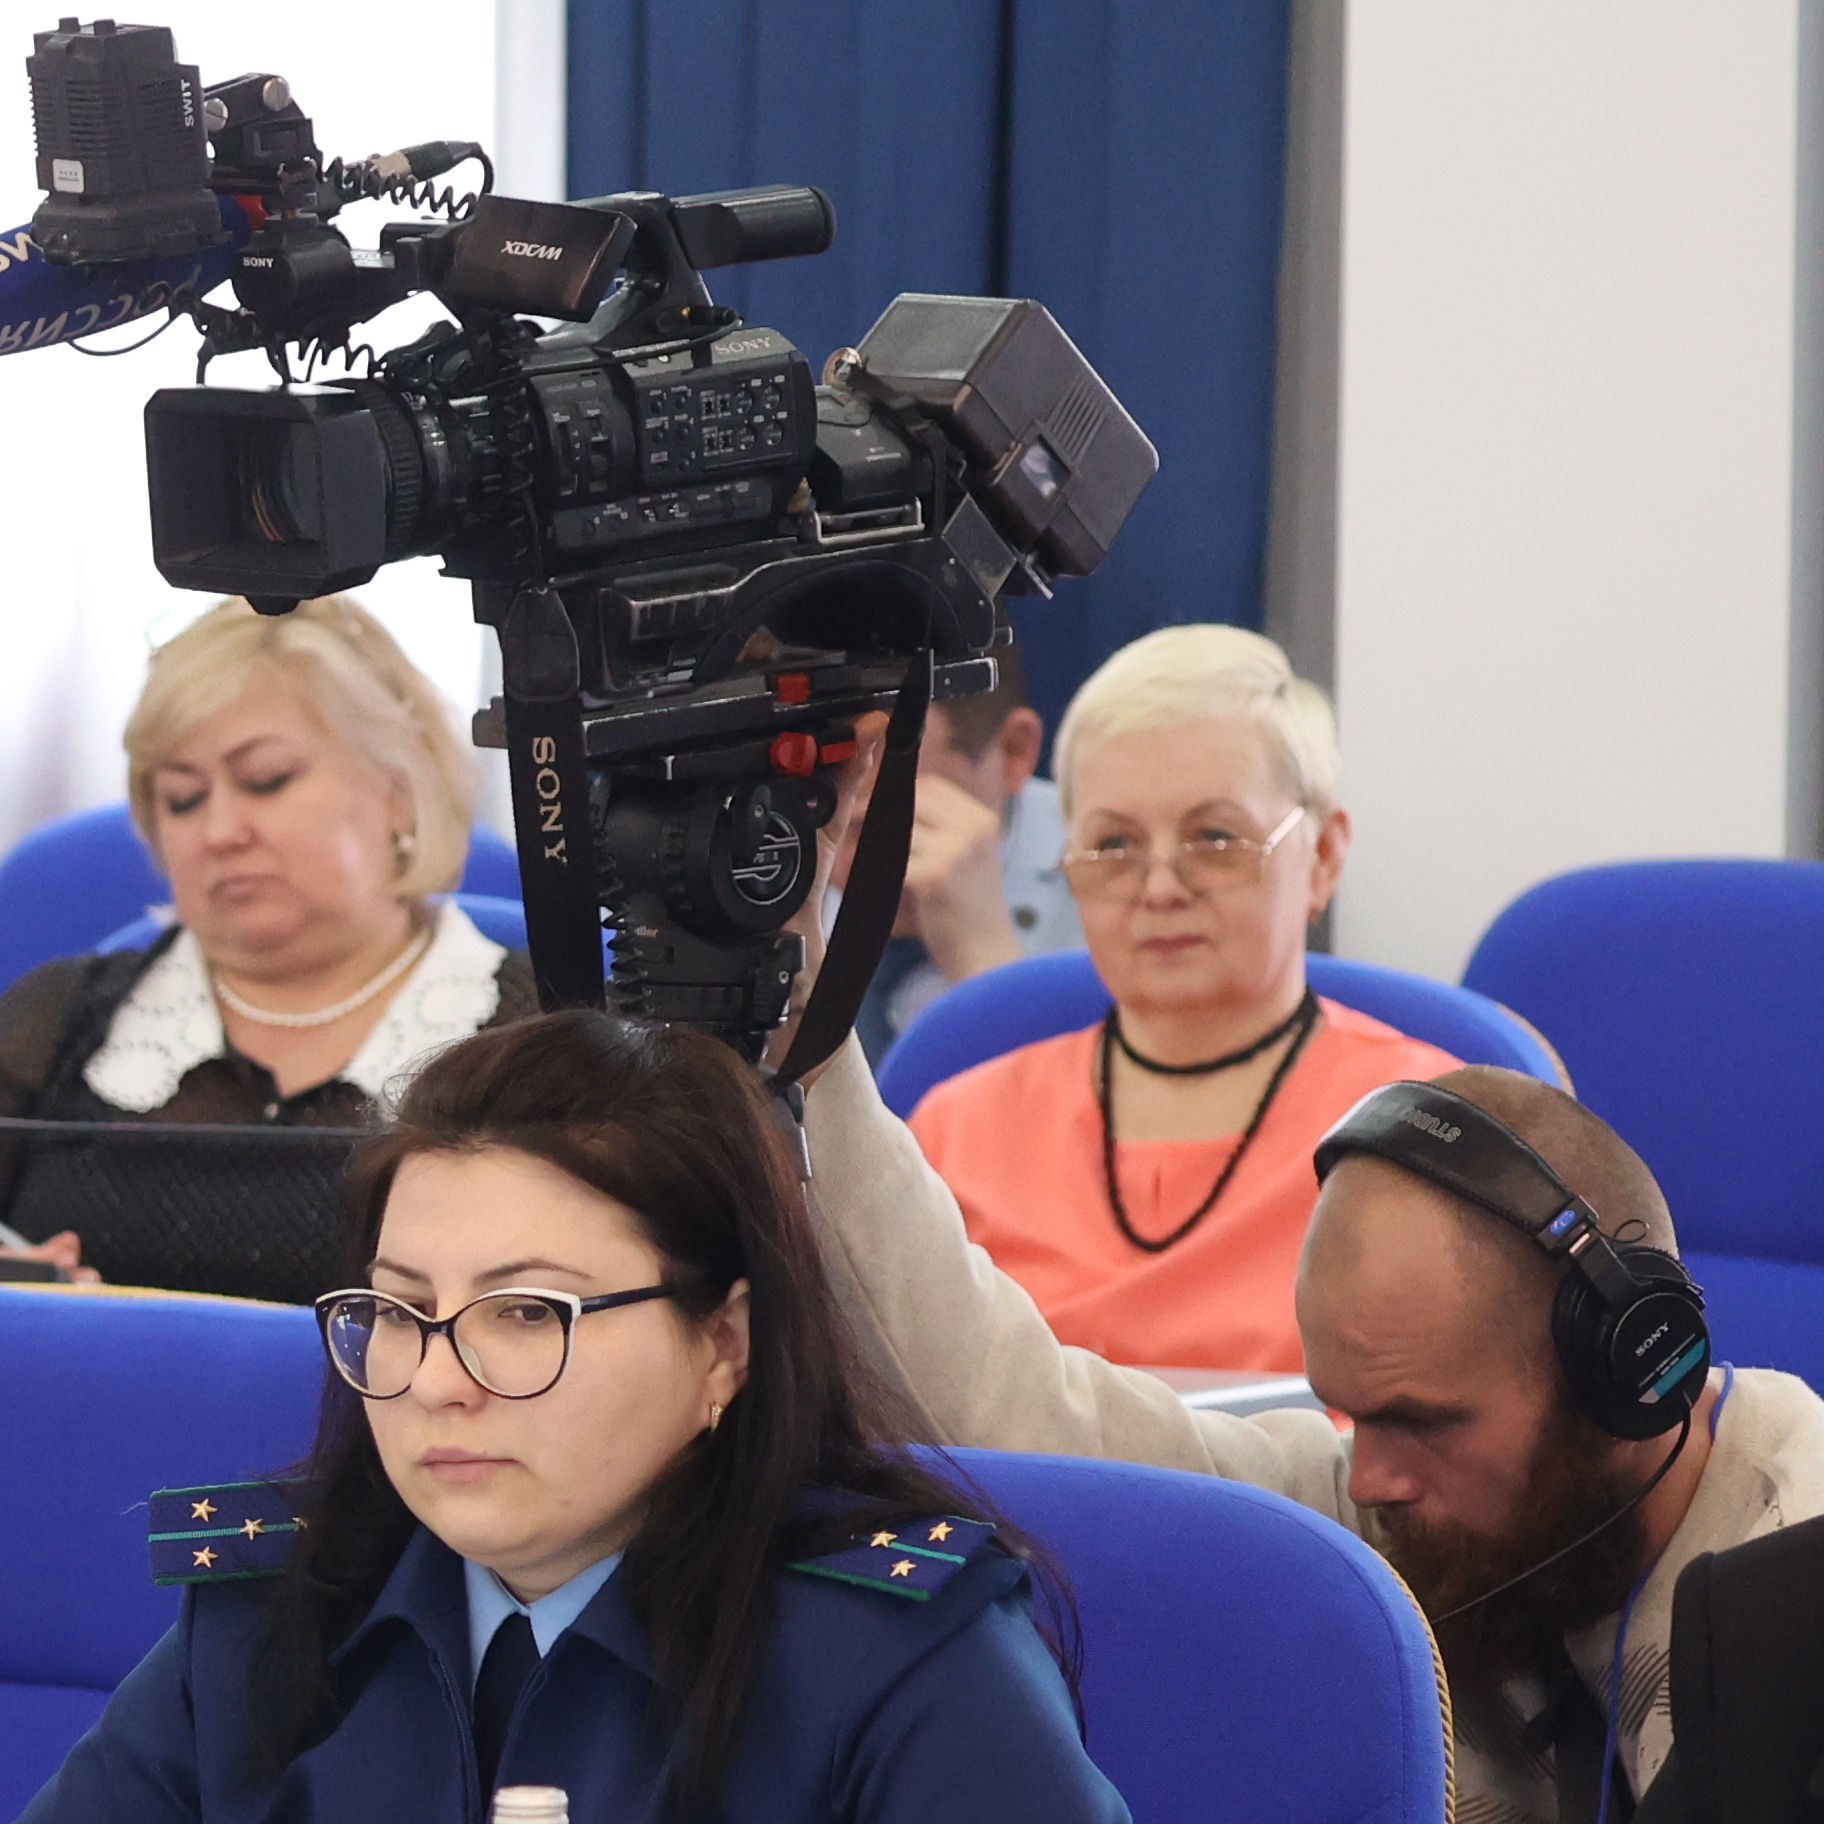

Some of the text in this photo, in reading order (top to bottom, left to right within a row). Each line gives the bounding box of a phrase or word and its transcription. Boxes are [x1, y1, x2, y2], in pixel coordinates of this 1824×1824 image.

[180, 78, 195, 129] SWIT
[242, 256, 275, 269] SONY
[500, 240, 563, 262] XDCAM
[532, 736, 568, 866] SONY
[1635, 1321, 1669, 1357] SONY
